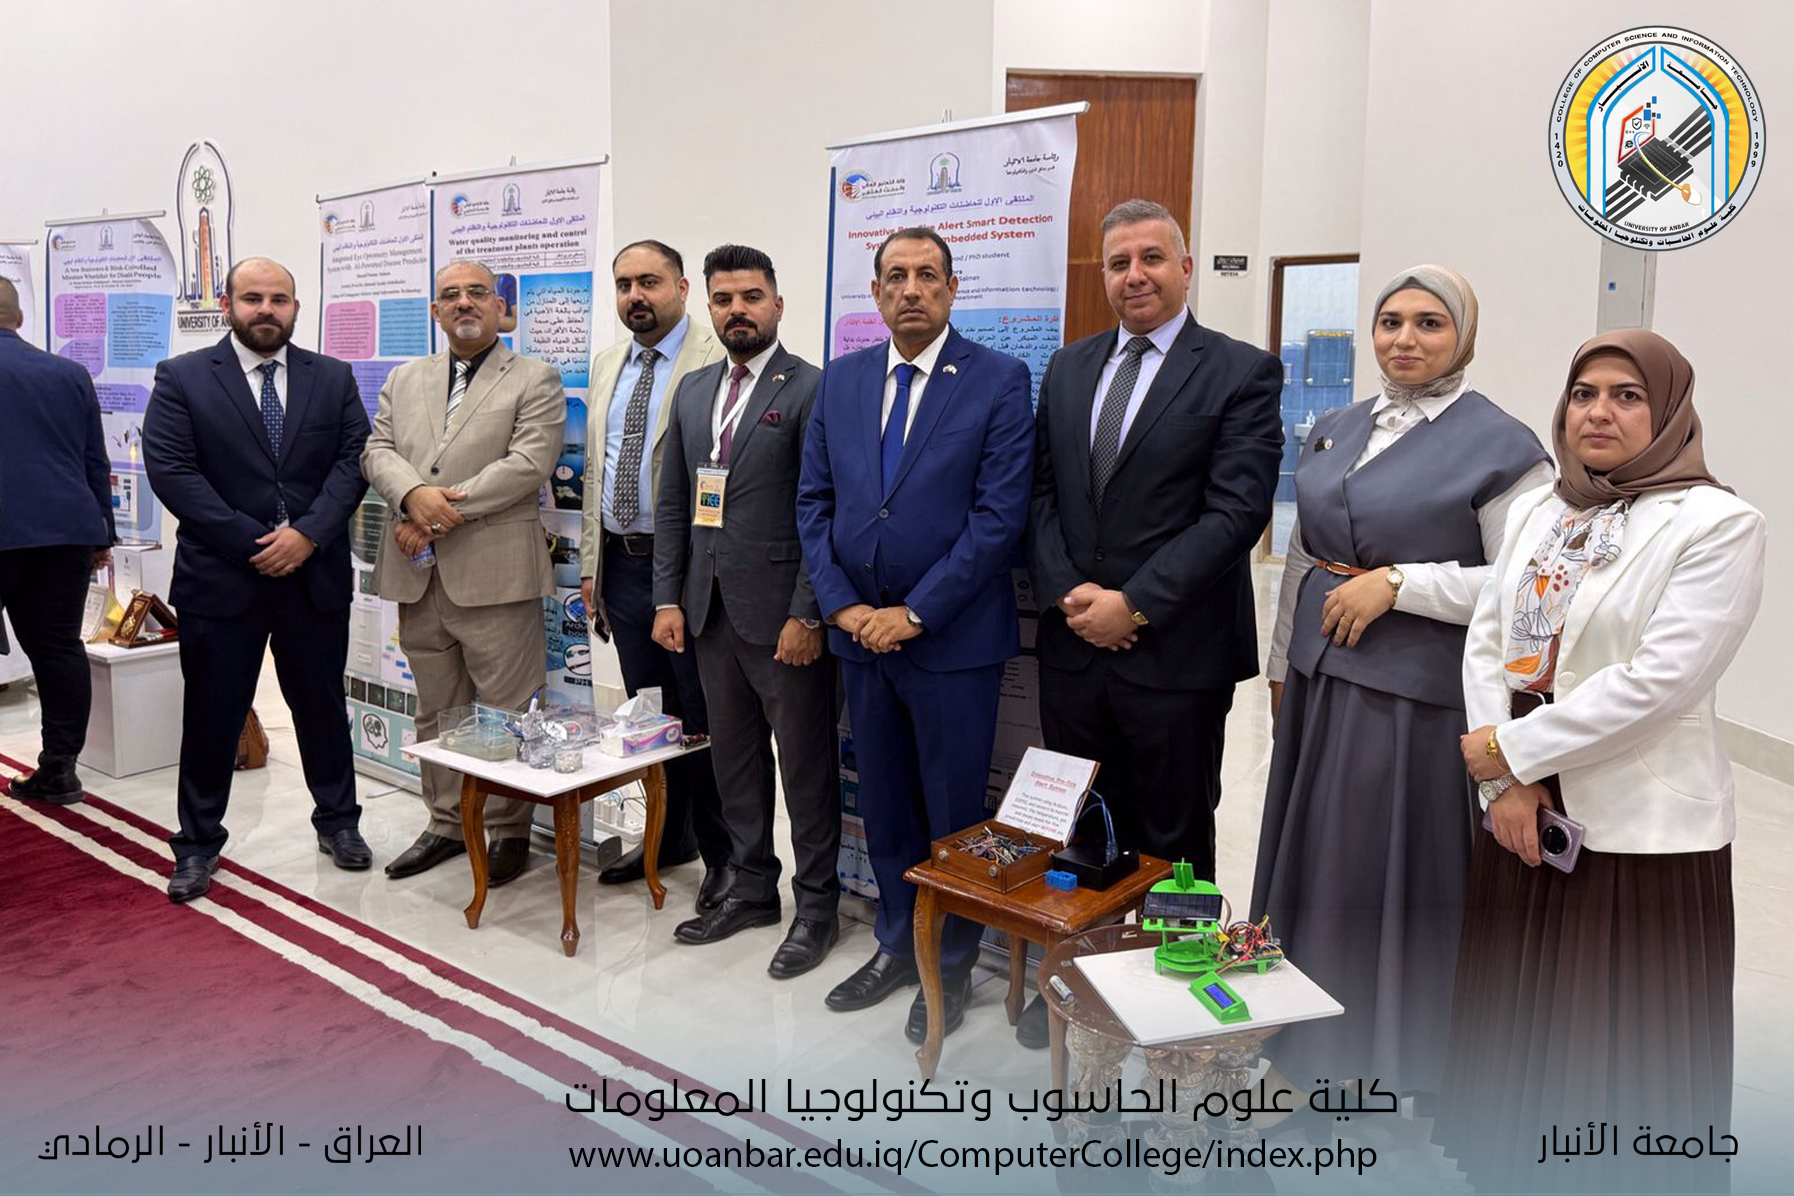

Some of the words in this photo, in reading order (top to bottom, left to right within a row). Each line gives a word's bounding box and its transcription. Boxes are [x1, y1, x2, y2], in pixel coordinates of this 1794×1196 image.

[848, 227, 896, 239] Innovative
[937, 220, 964, 232] Alert
[966, 216, 996, 229] Smart
[998, 213, 1054, 226] Detection
[447, 237, 470, 247] Water
[470, 234, 497, 246] quality
[497, 230, 541, 243] monitoring
[541, 229, 559, 240] and
[559, 227, 588, 238] control
[941, 231, 989, 244] mbedded
[990, 229, 1036, 242] System
[455, 248, 464, 256] of
[464, 247, 475, 255] the
[476, 244, 514, 254] treatment
[514, 242, 539, 253] plants
[539, 239, 580, 251] operation
[212, 315, 220, 328] OF
